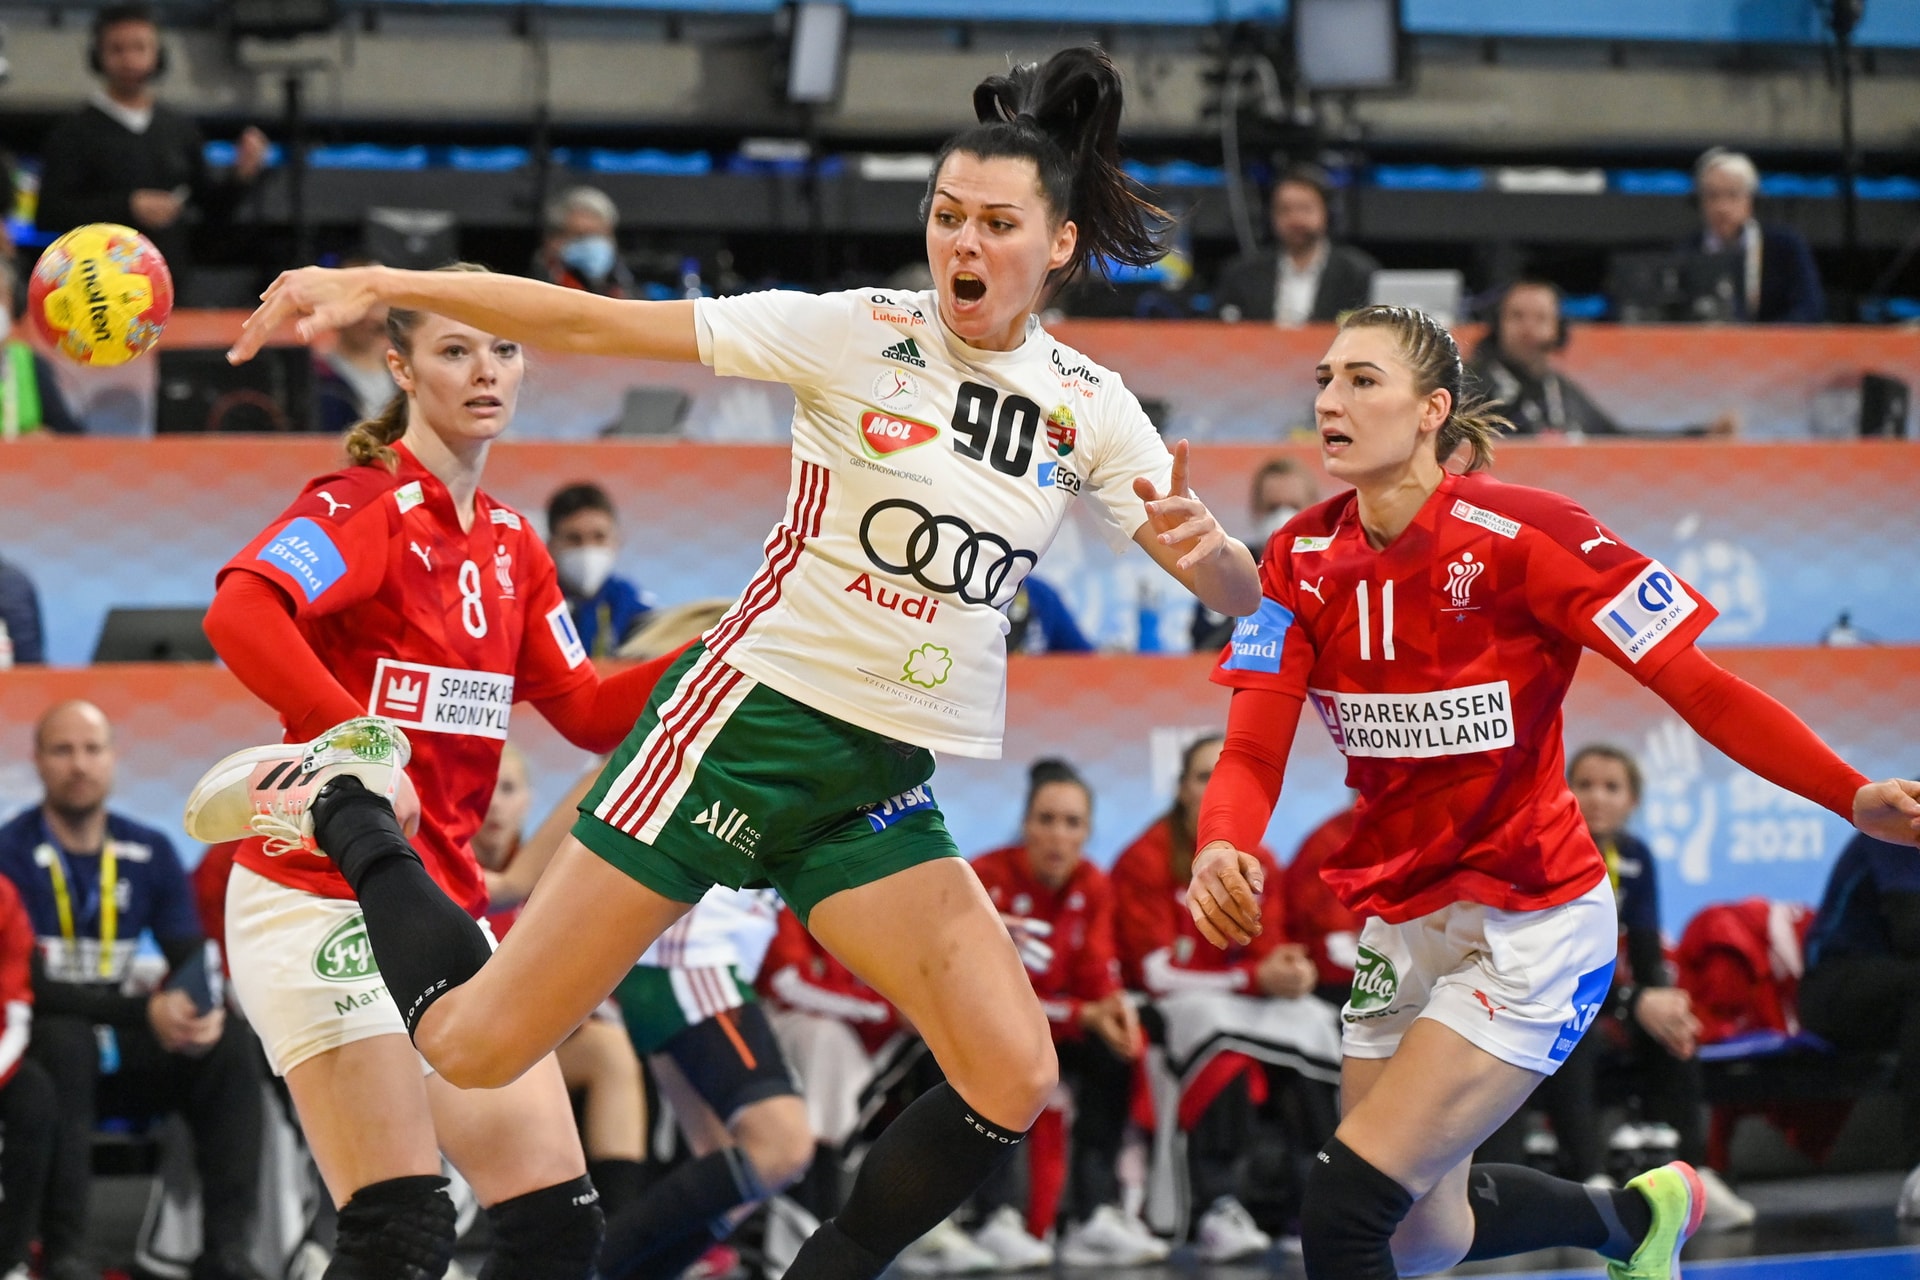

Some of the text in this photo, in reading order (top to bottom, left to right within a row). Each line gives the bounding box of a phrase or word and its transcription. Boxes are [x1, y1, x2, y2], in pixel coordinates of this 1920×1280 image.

[80, 258, 111, 342] molten
[872, 310, 908, 325] Lutein
[881, 349, 927, 369] adidas
[1051, 348, 1100, 385] Ocuvite
[866, 416, 913, 441] MOL
[950, 380, 1041, 478] 90
[849, 457, 866, 469] GBS
[279, 535, 321, 564] Alm
[269, 543, 323, 593] Brand
[457, 559, 489, 639] 8
[844, 572, 941, 625] Audi
[1451, 598, 1471, 608] DHF
[1355, 579, 1397, 661] 11
[1231, 641, 1277, 660] rand
[1340, 692, 1505, 724] SPAREKASSEN
[1345, 718, 1509, 749] KRONJYLLAND
[880, 784, 931, 816] JYSK
[738, 833, 756, 848] LIVE
[1730, 818, 1825, 863] 2021
